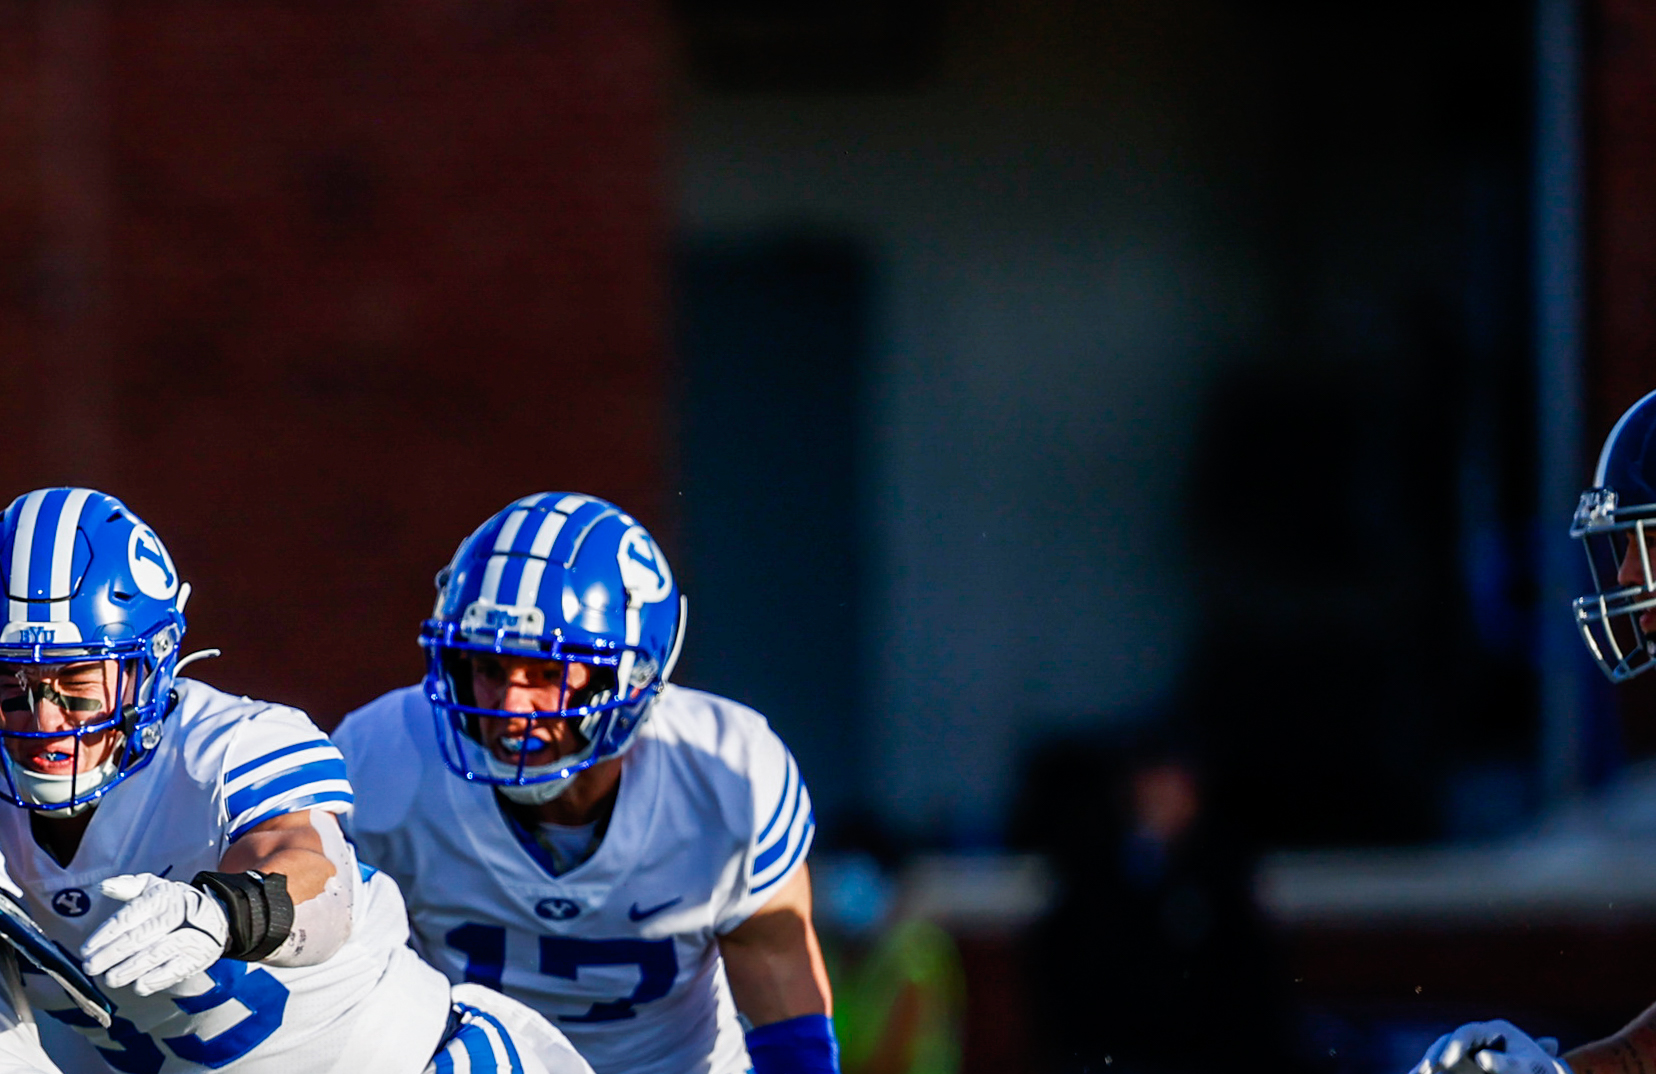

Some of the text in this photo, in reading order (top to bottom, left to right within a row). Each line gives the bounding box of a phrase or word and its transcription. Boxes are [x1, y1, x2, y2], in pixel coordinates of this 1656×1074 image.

[134, 529, 174, 589] Y
[627, 533, 665, 590] Y
[19, 626, 56, 644] BYU
[55, 891, 82, 914] Y
[445, 921, 680, 1023] 17
